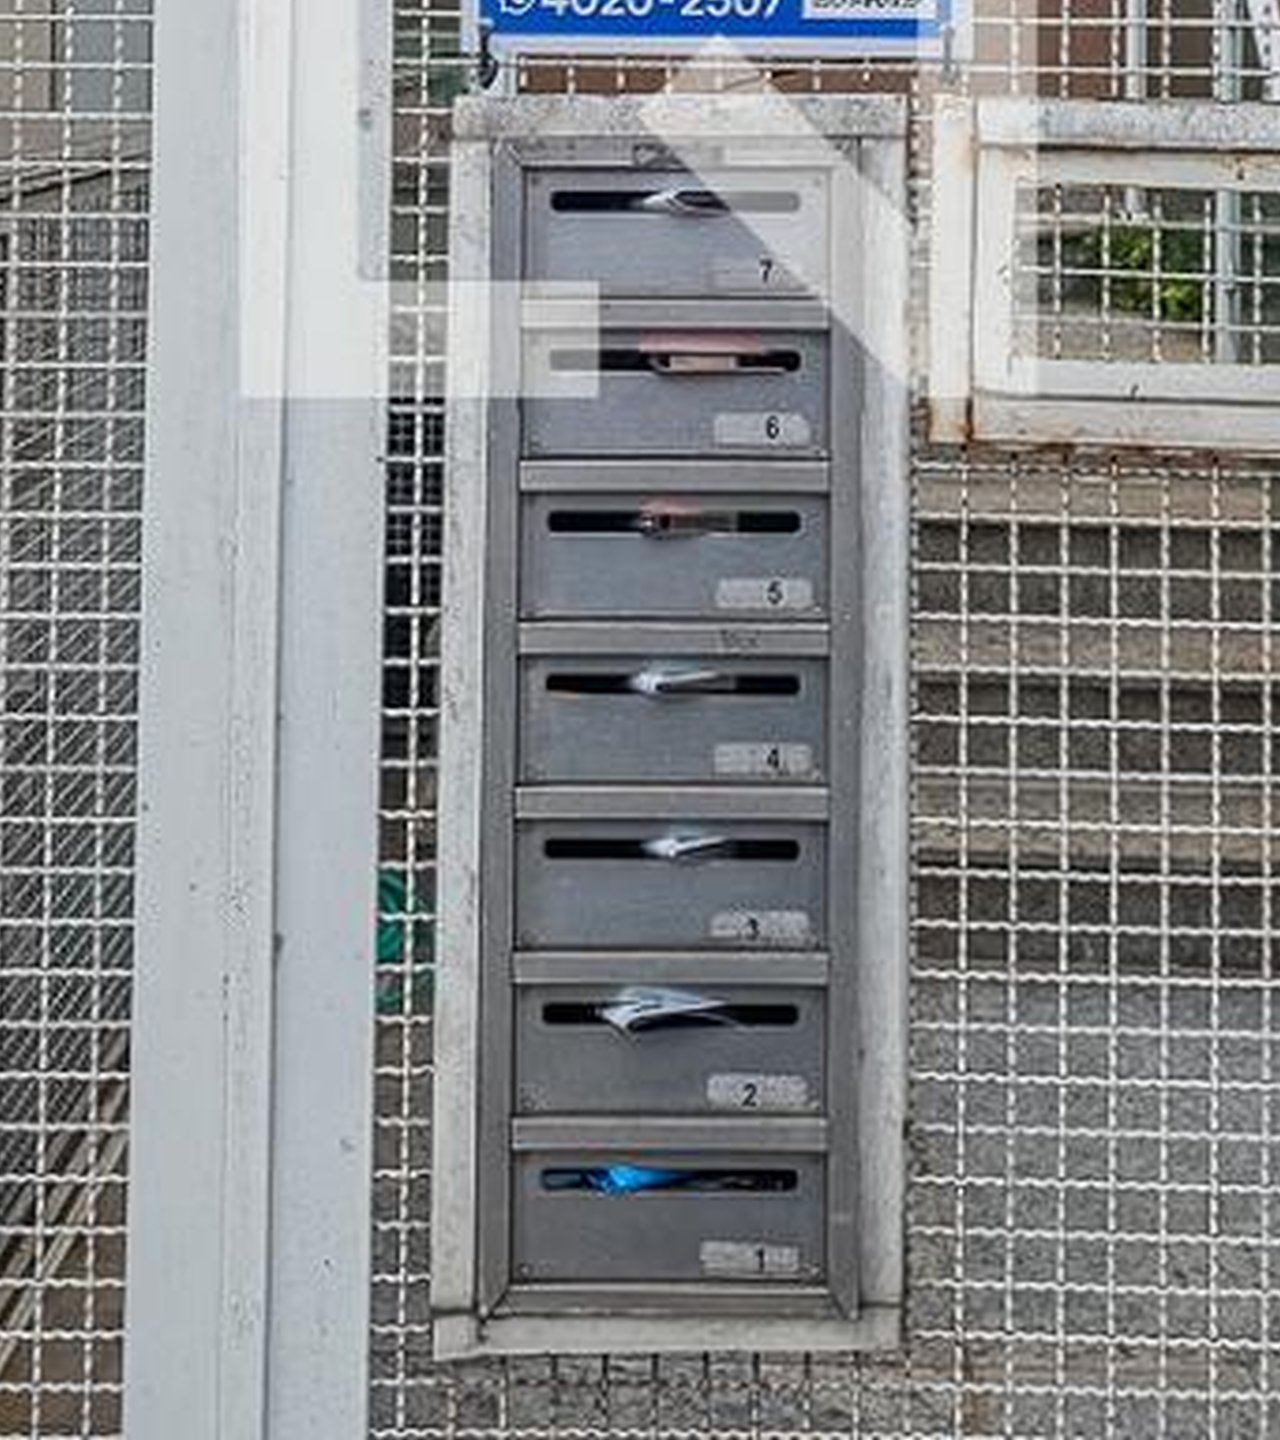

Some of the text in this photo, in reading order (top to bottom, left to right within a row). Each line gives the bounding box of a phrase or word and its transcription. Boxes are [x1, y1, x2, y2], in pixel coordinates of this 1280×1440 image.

[758, 259, 774, 283] 7
[765, 416, 780, 440] 6
[766, 581, 784, 605] 5
[766, 747, 780, 769] 4
[745, 917, 760, 939] 3
[742, 1083, 758, 1107] 2
[756, 1247, 767, 1271] 1
